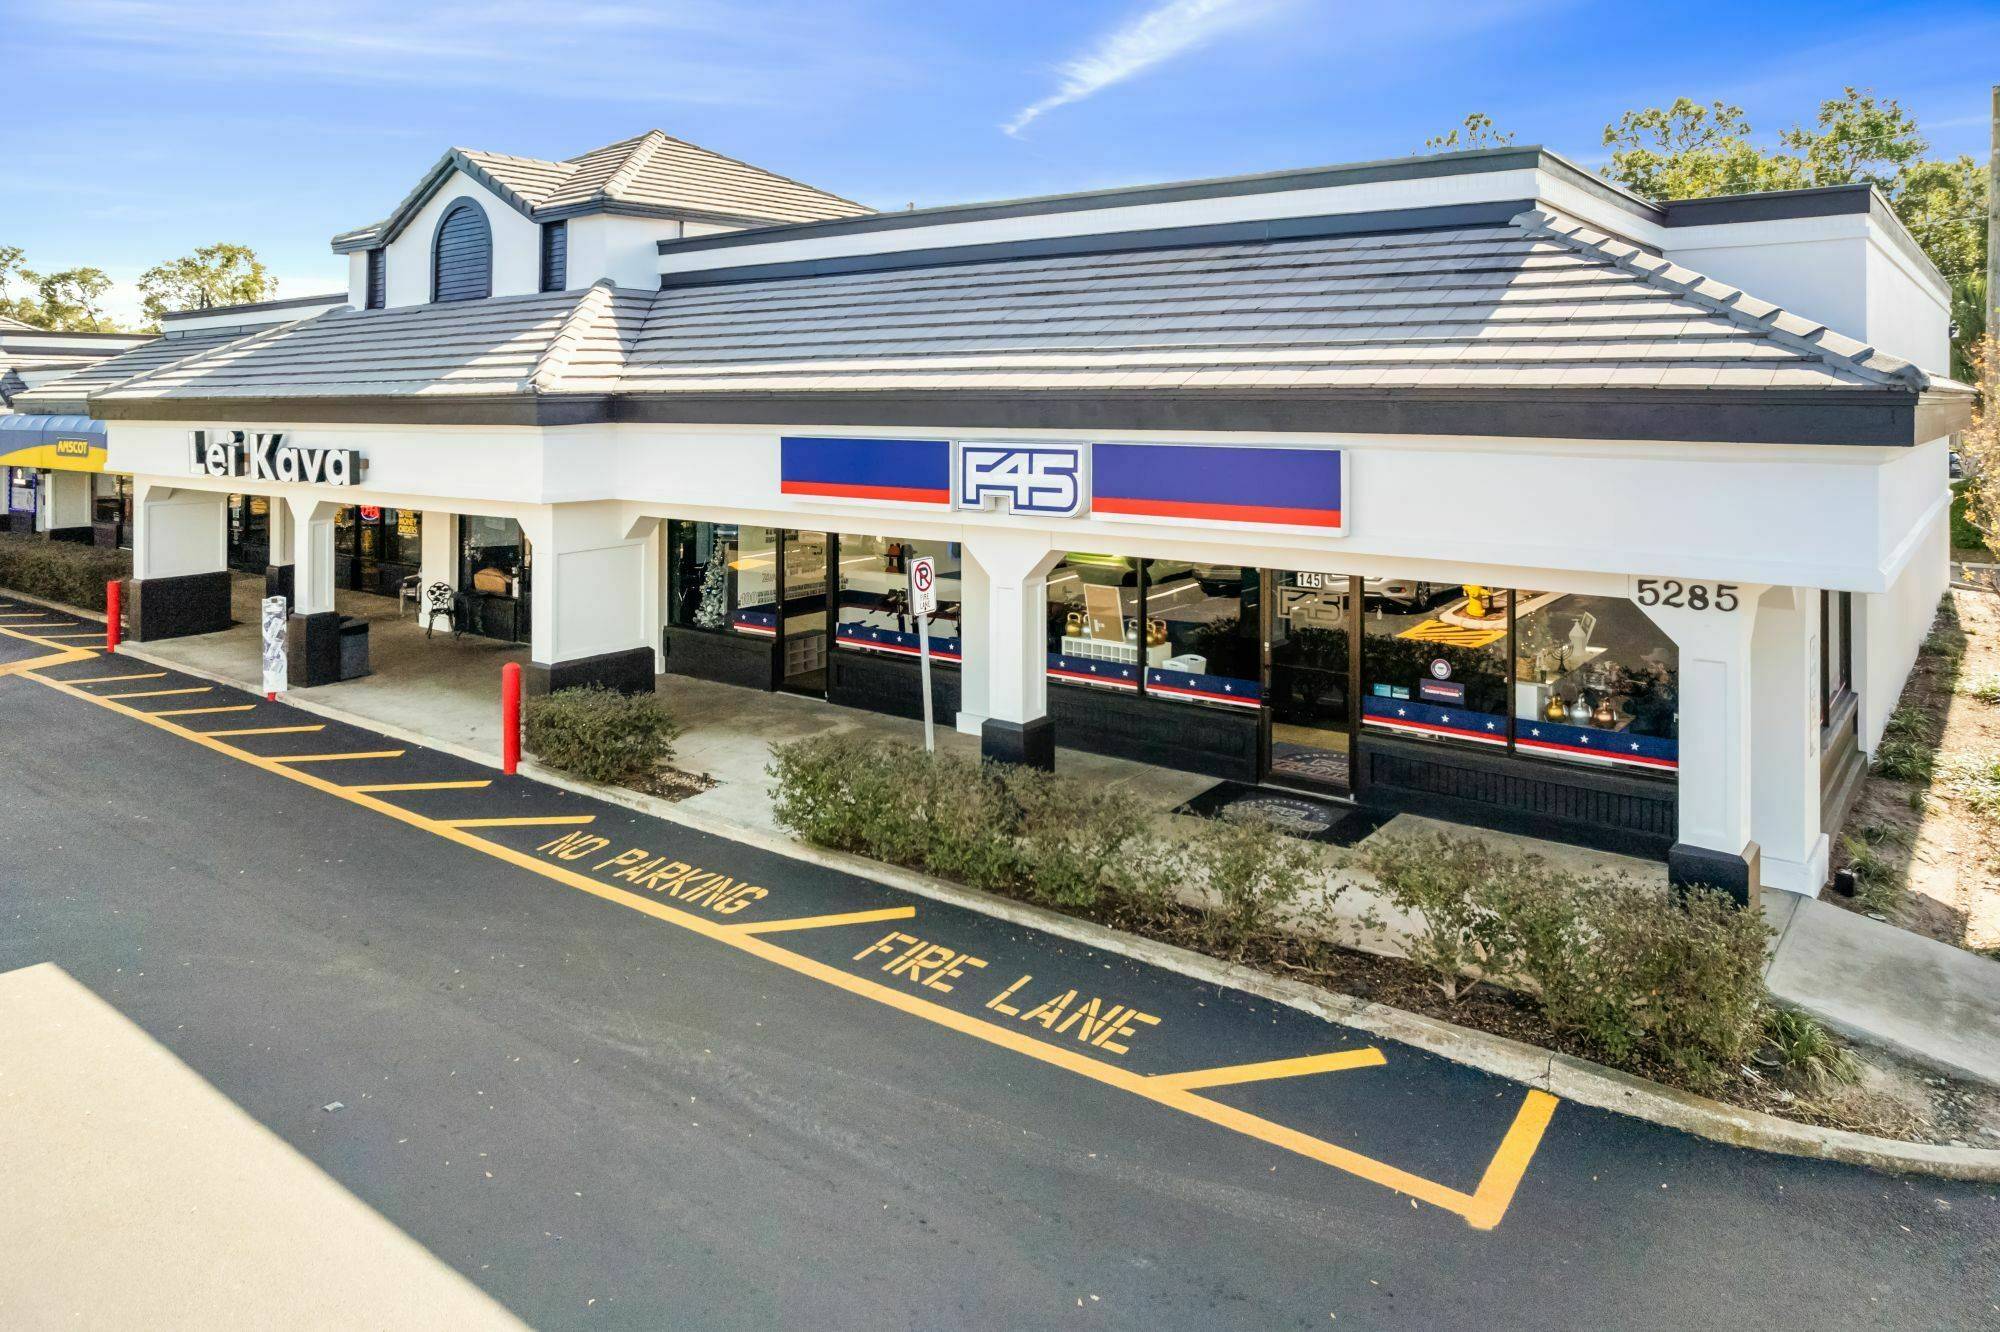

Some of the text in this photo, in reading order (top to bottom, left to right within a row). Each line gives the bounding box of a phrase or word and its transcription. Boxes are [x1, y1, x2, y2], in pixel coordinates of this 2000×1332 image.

[57, 440, 88, 454] AMSCOT
[188, 430, 360, 487] Lei Kava
[962, 446, 1079, 514] F45
[1299, 573, 1321, 587] 145
[1637, 579, 1739, 612] 5285
[1278, 587, 1343, 622] F45
[536, 830, 769, 914] NO PARKING
[852, 931, 1162, 1055] FIRE LANE
